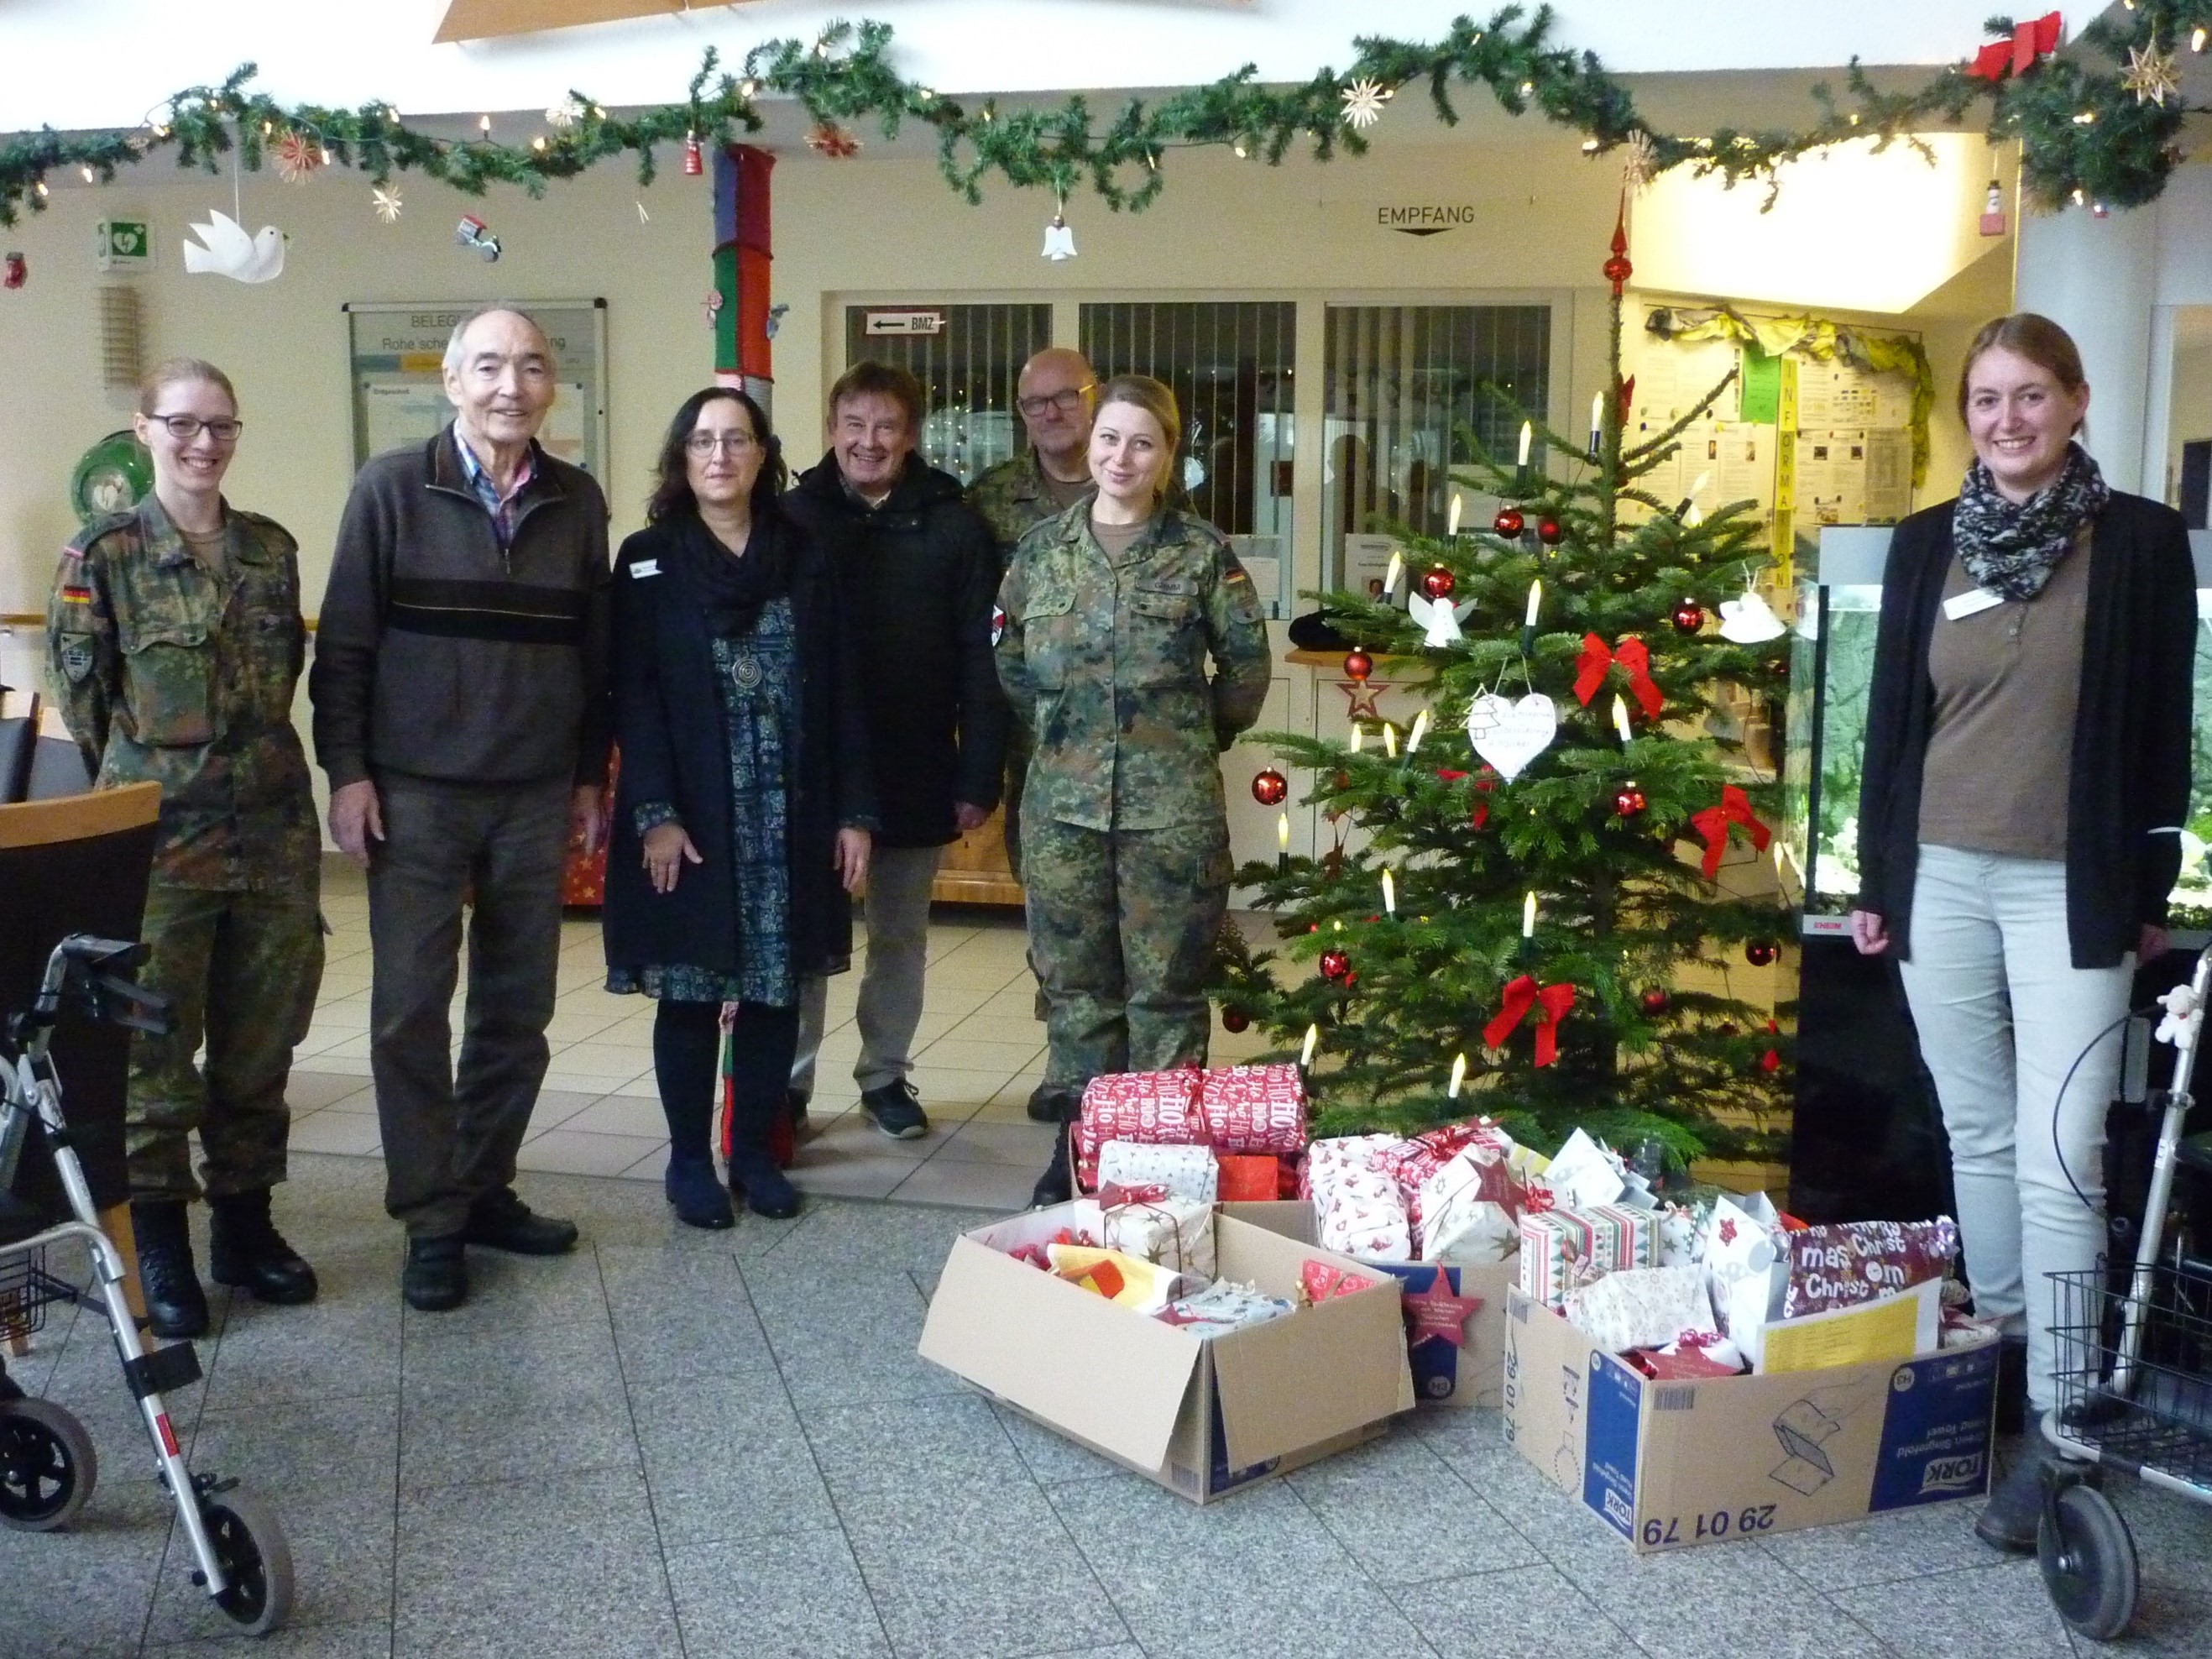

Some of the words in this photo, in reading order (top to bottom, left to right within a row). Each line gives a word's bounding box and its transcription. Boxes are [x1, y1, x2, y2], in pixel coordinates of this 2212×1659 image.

[1378, 207, 1475, 224] EMPFANG
[912, 317, 933, 330] BMZ
[1802, 1245, 1852, 1270] mas
[1851, 1232, 1906, 1258] Christ
[1806, 1273, 1869, 1299] Christ
[1506, 1384, 1516, 1409] 01
[1927, 1456, 1981, 1484] TORK
[1607, 1493, 1633, 1525] TORK
[1739, 1504, 1777, 1533] 29
[1643, 1517, 1680, 1546] 79
[1695, 1511, 1729, 1539] 01
